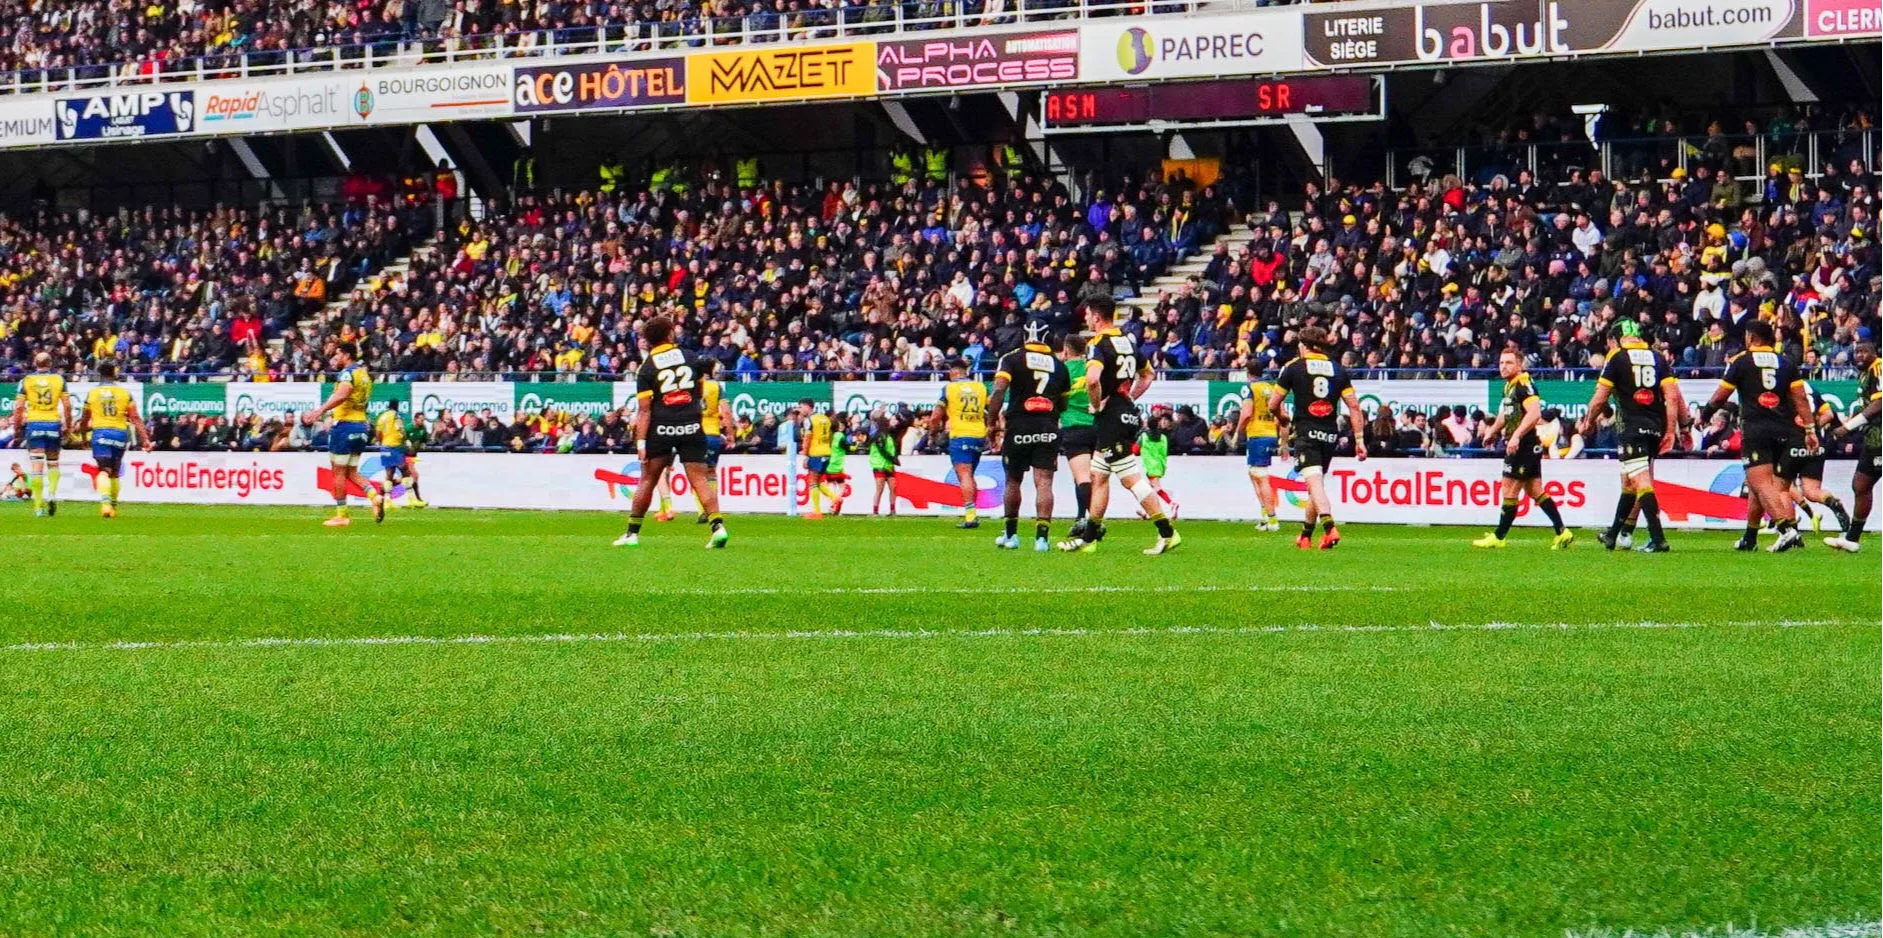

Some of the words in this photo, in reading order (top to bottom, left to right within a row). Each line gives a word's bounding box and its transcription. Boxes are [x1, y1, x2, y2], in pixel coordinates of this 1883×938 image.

[1324, 16, 1384, 37] LITERIE
[1649, 5, 1772, 29] babut.com
[1416, 2, 1569, 60] babut
[878, 38, 997, 66] ALPHA
[1161, 32, 1265, 61] PAPREC
[1330, 39, 1378, 59] SIÈGE
[711, 49, 854, 95] MAZET
[896, 57, 1076, 88] PROCESS
[378, 74, 508, 95] BOURGOIGNON
[516, 71, 574, 106] ace
[579, 63, 684, 102] HÔTEL
[82, 92, 166, 119] AMP
[1047, 94, 1095, 120] ASM
[1258, 84, 1291, 110] SR
[1116, 355, 1136, 379] 20
[1631, 365, 1656, 388] 18
[657, 365, 695, 394] 22
[1033, 371, 1049, 394] 7
[1313, 376, 1329, 399] 8
[1762, 368, 1777, 390] 5
[166, 398, 225, 412] Groupama
[257, 398, 315, 412] Groupama
[444, 398, 508, 414] Groupama
[960, 396, 980, 413] 23
[656, 423, 701, 436] COGEP
[1014, 432, 1057, 444] COGEP
[131, 461, 284, 497] TotalEnergies
